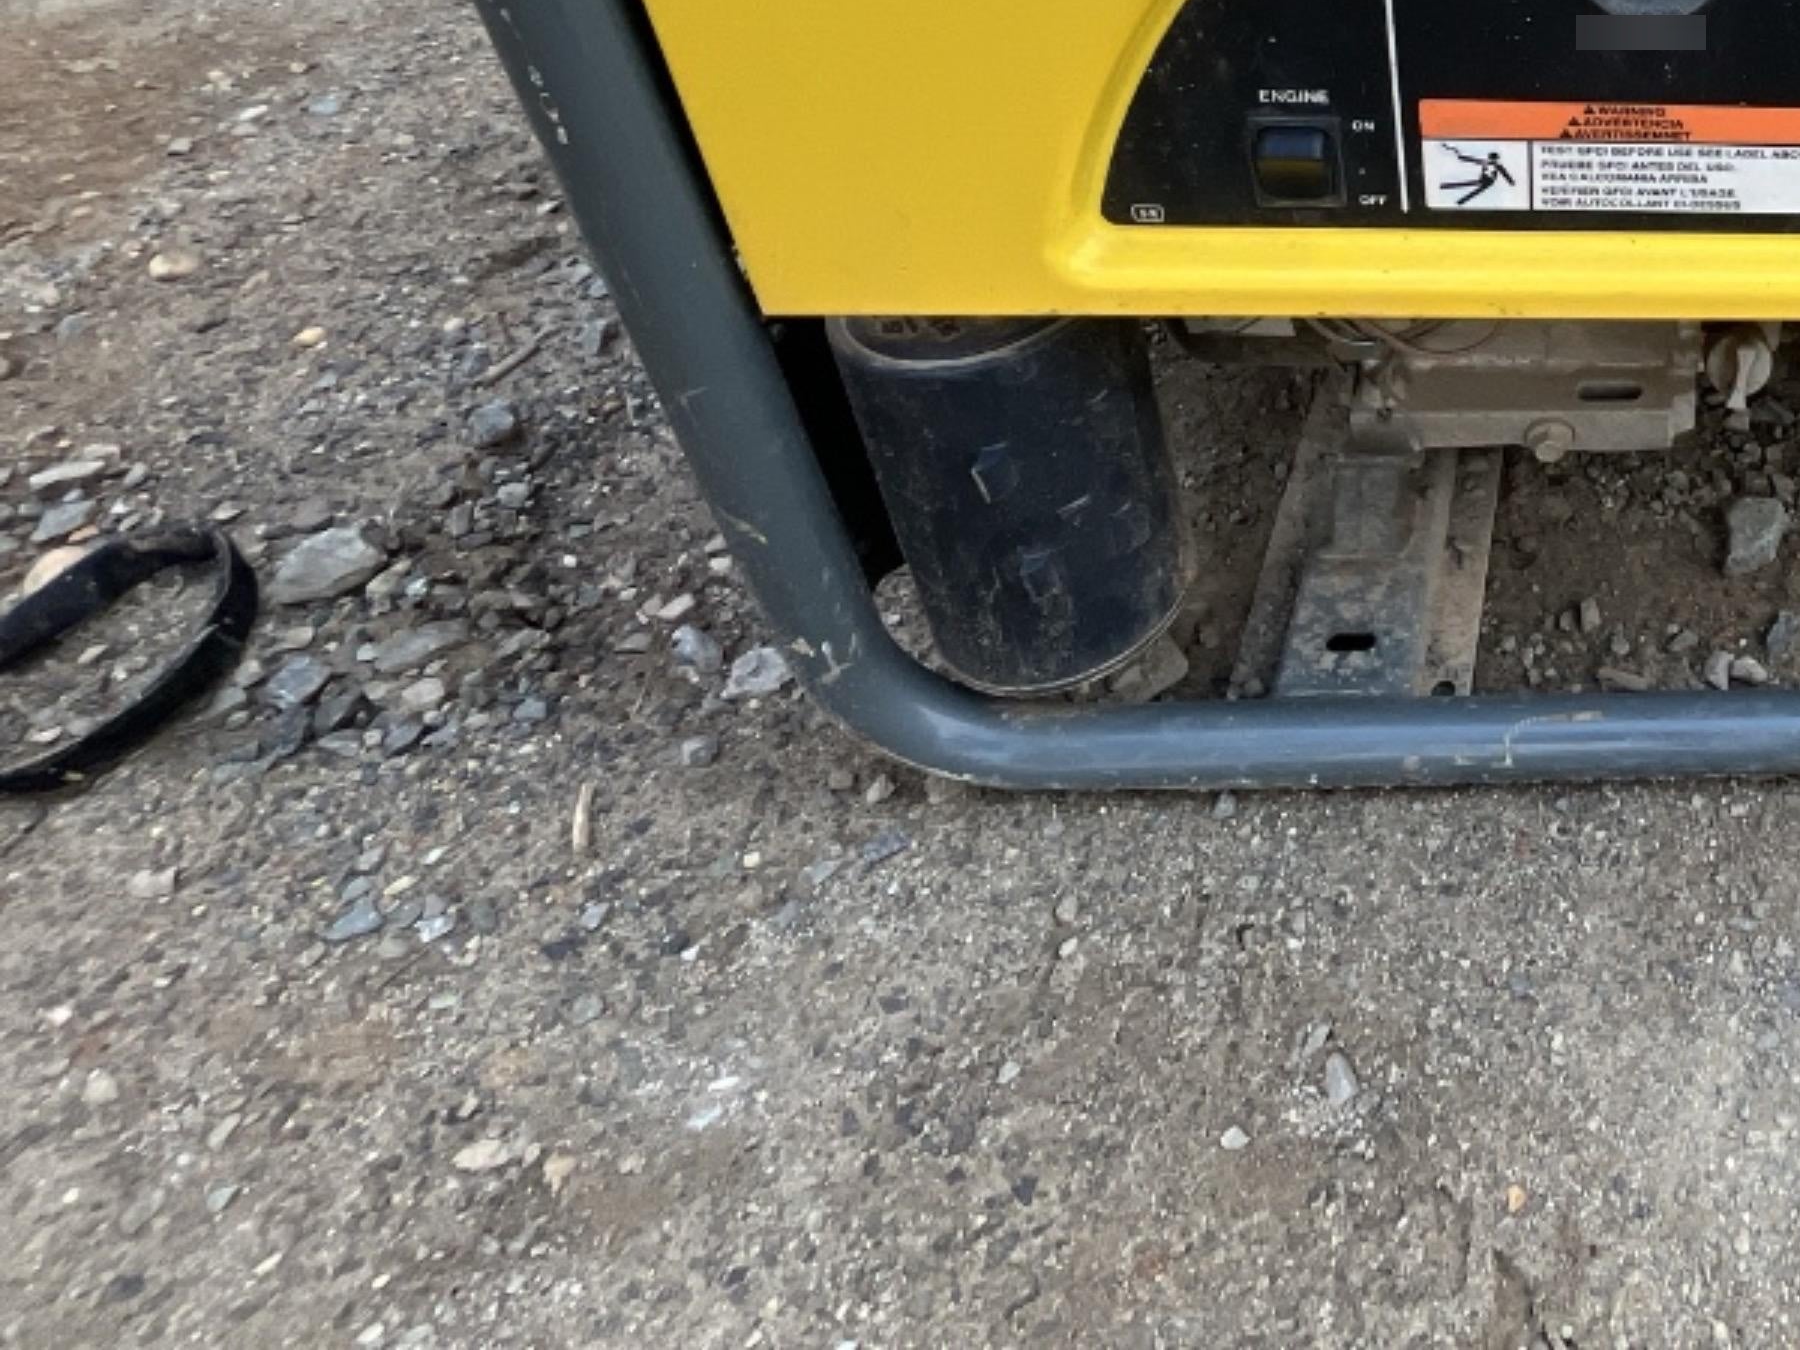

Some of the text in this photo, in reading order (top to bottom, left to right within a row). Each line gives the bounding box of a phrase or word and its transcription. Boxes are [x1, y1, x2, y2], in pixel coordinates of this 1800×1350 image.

[1258, 89, 1329, 105] ENGINE
[1351, 119, 1375, 132] ON
[1359, 195, 1387, 206] OFF
